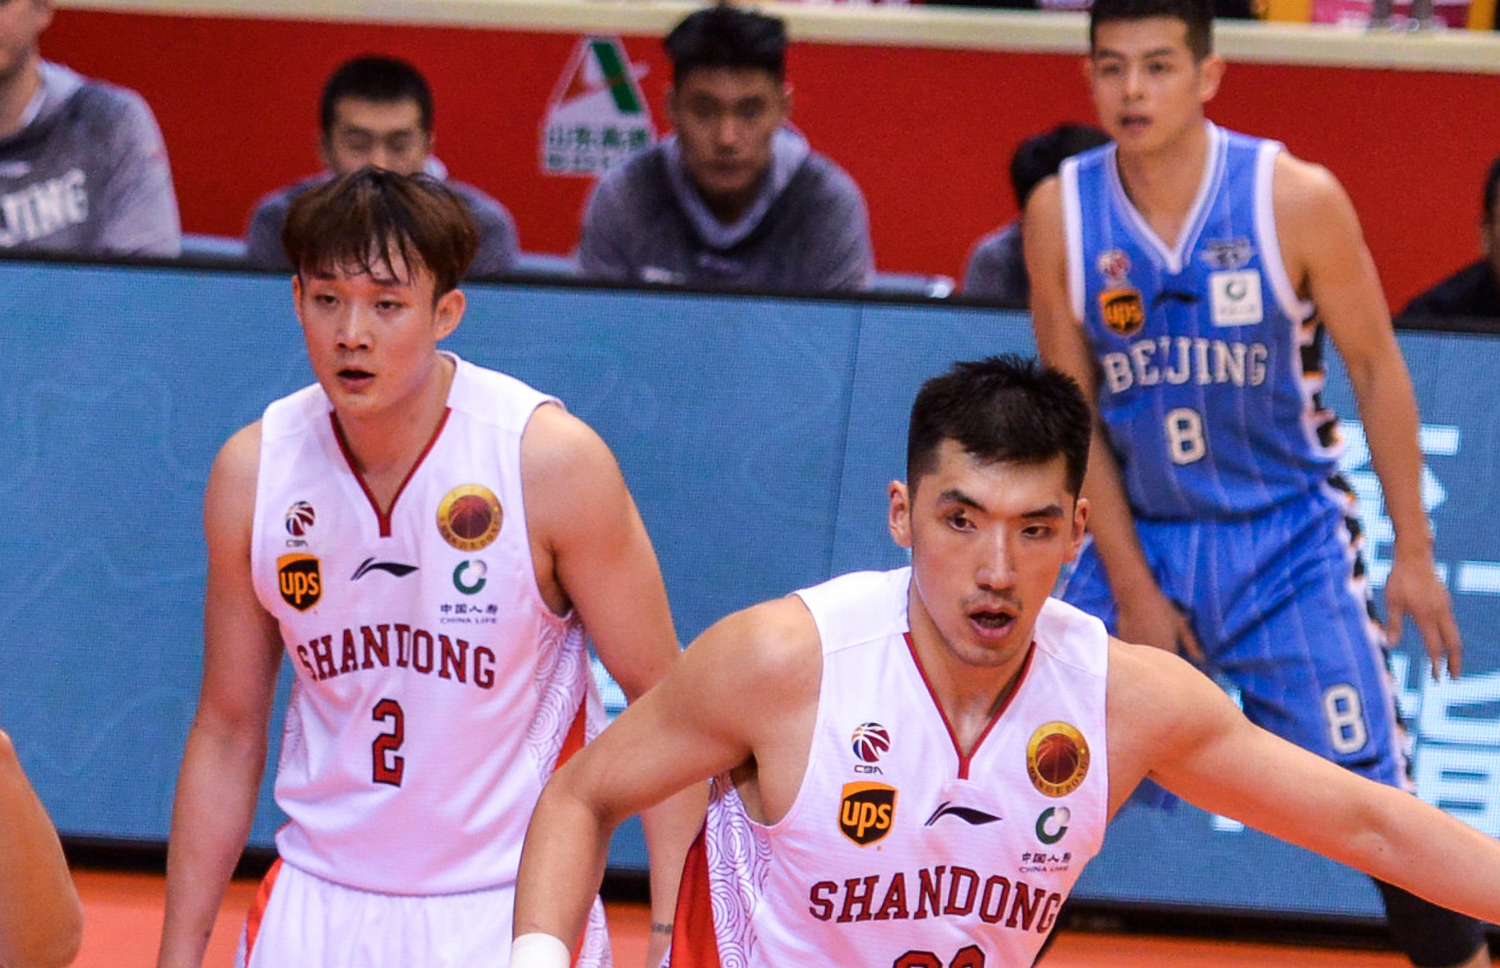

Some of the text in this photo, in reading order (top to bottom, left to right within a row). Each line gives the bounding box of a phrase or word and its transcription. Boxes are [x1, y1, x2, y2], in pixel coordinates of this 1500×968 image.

[1103, 337, 1269, 394] BEIJING
[1164, 407, 1206, 466] 8
[280, 571, 320, 604] ups
[372, 697, 405, 787] 2
[1323, 683, 1370, 754] 8
[854, 764, 884, 776] CBA
[842, 800, 892, 837] ups
[808, 865, 1061, 934] SHANDONG
